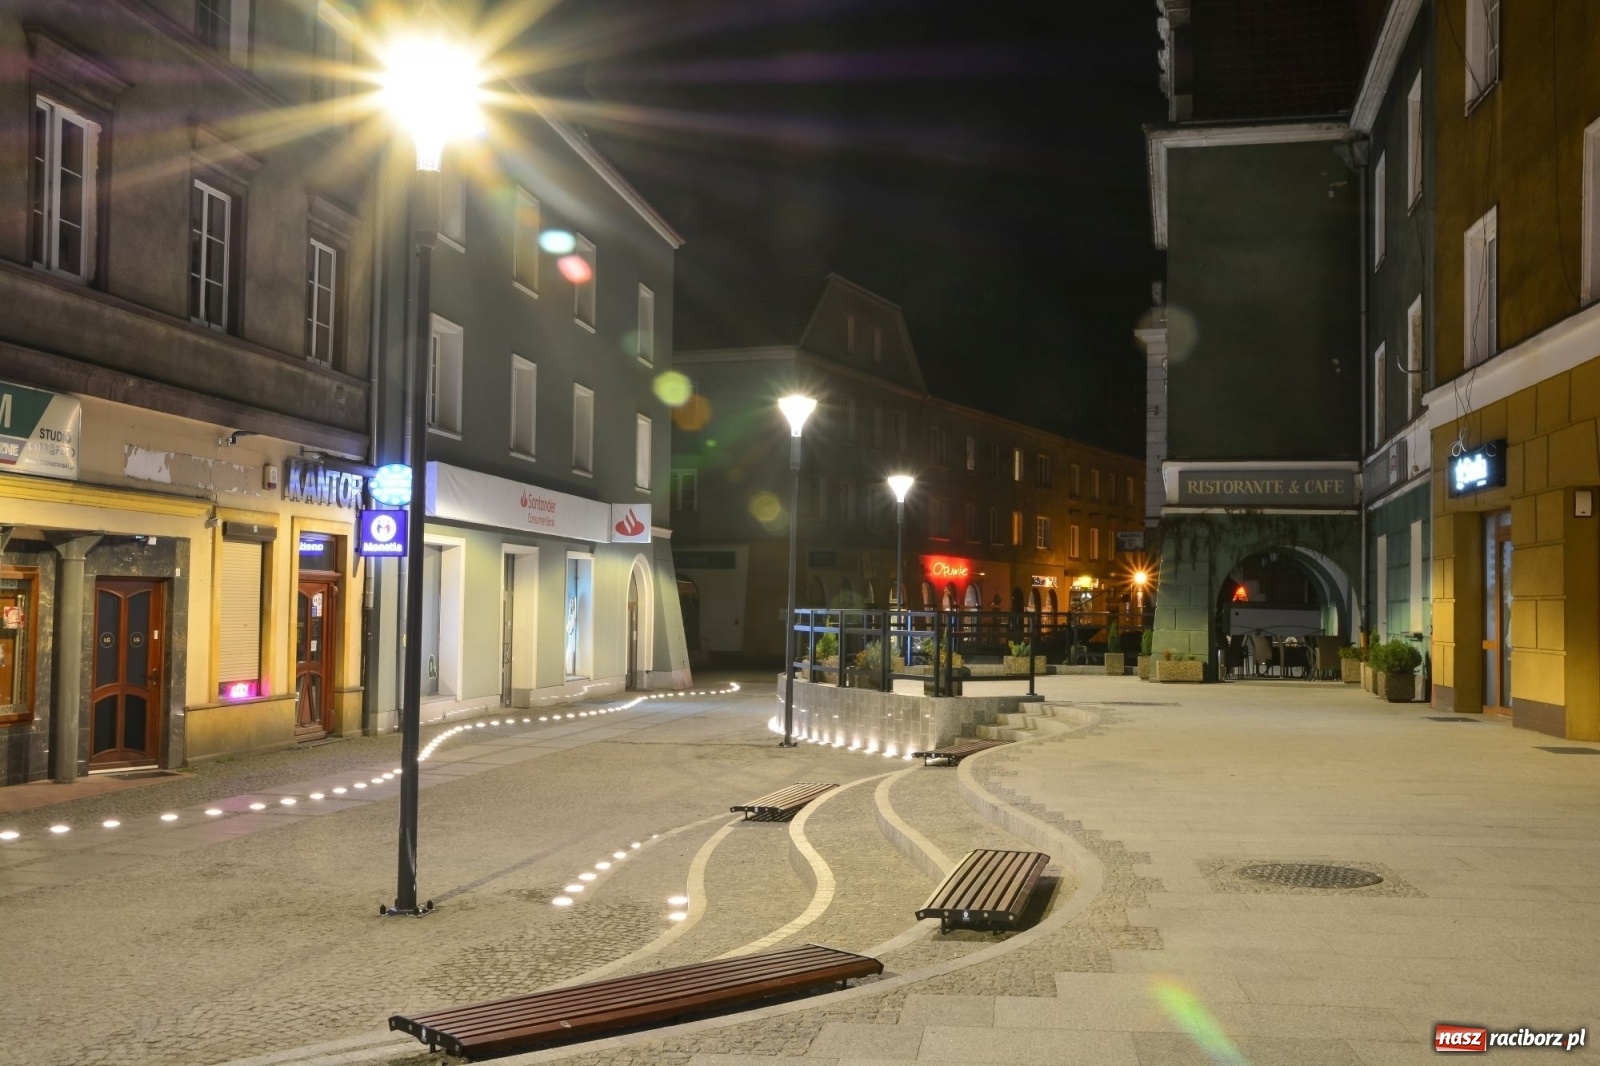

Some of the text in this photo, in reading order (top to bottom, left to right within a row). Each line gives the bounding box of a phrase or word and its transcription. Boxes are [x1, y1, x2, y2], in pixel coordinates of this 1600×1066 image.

[289, 460, 364, 510] KANTOR
[1187, 480, 1344, 495] RISTORANTE & CAFE
[528, 493, 557, 513] Santander
